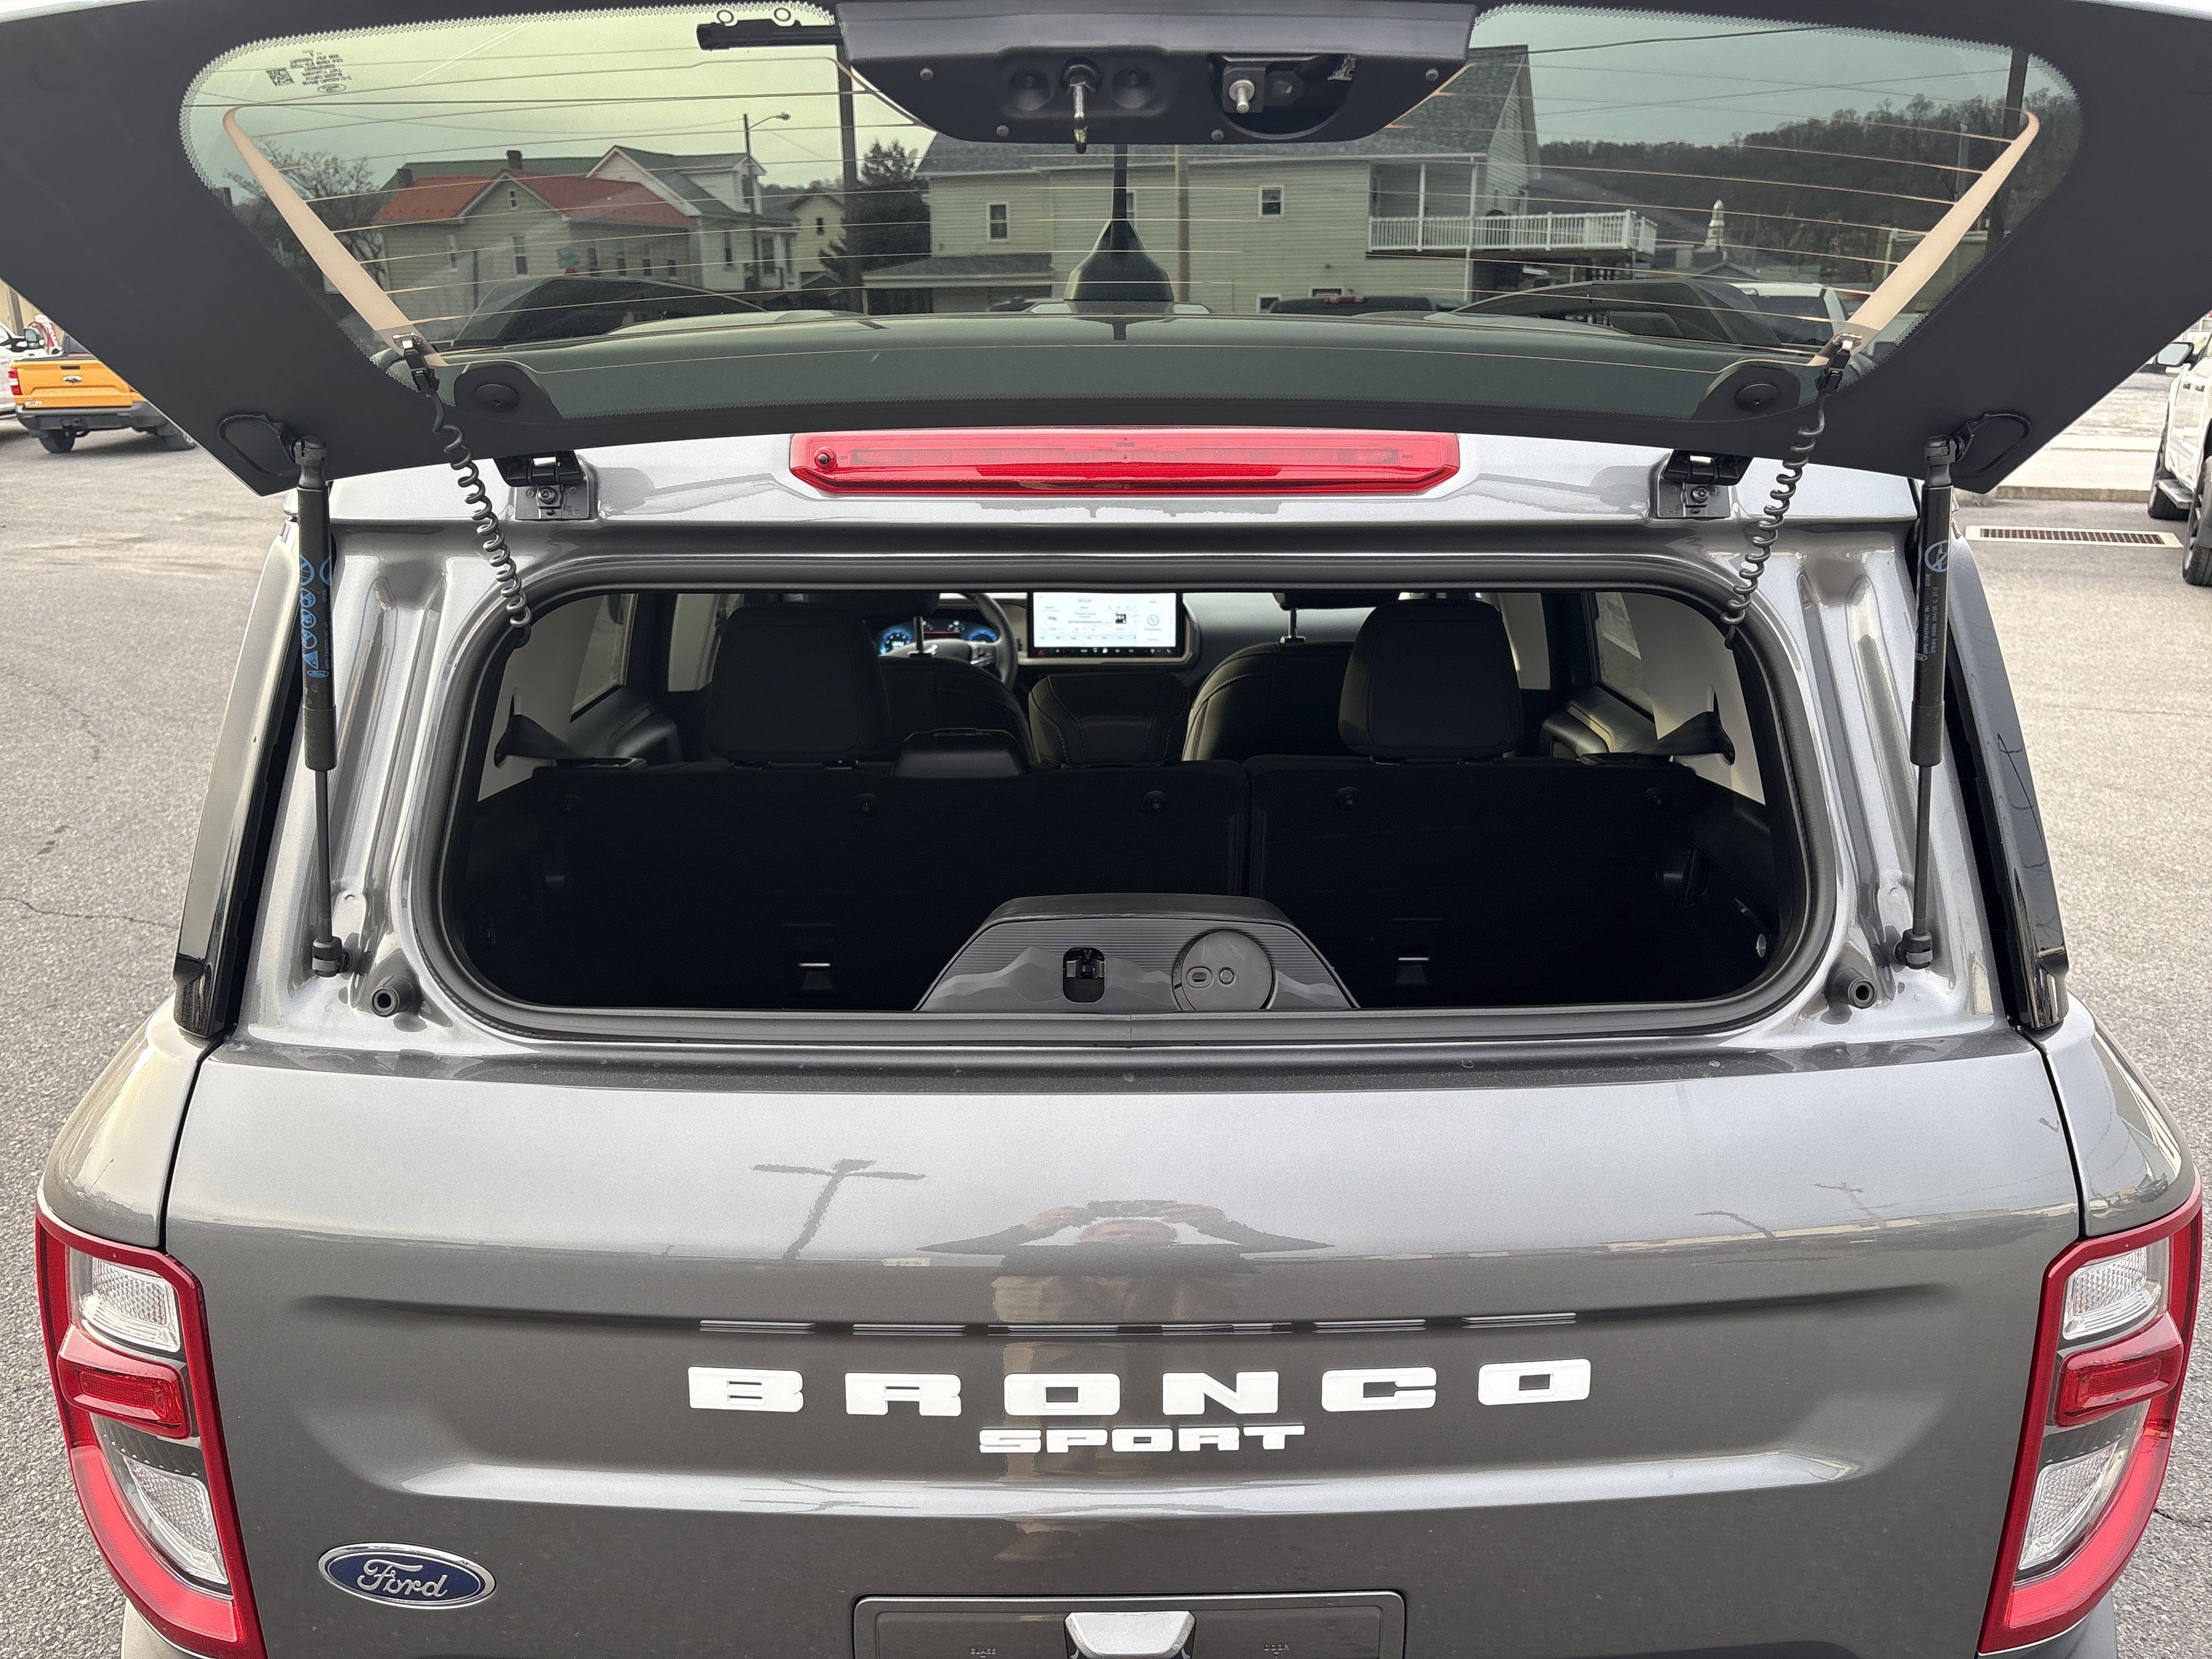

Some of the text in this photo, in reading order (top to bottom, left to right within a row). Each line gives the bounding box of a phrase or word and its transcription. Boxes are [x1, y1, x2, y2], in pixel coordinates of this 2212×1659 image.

[687, 1358, 1592, 1417] BRONCO
[979, 1425, 1305, 1454] SPORT
[357, 1559, 448, 1598] Ford
